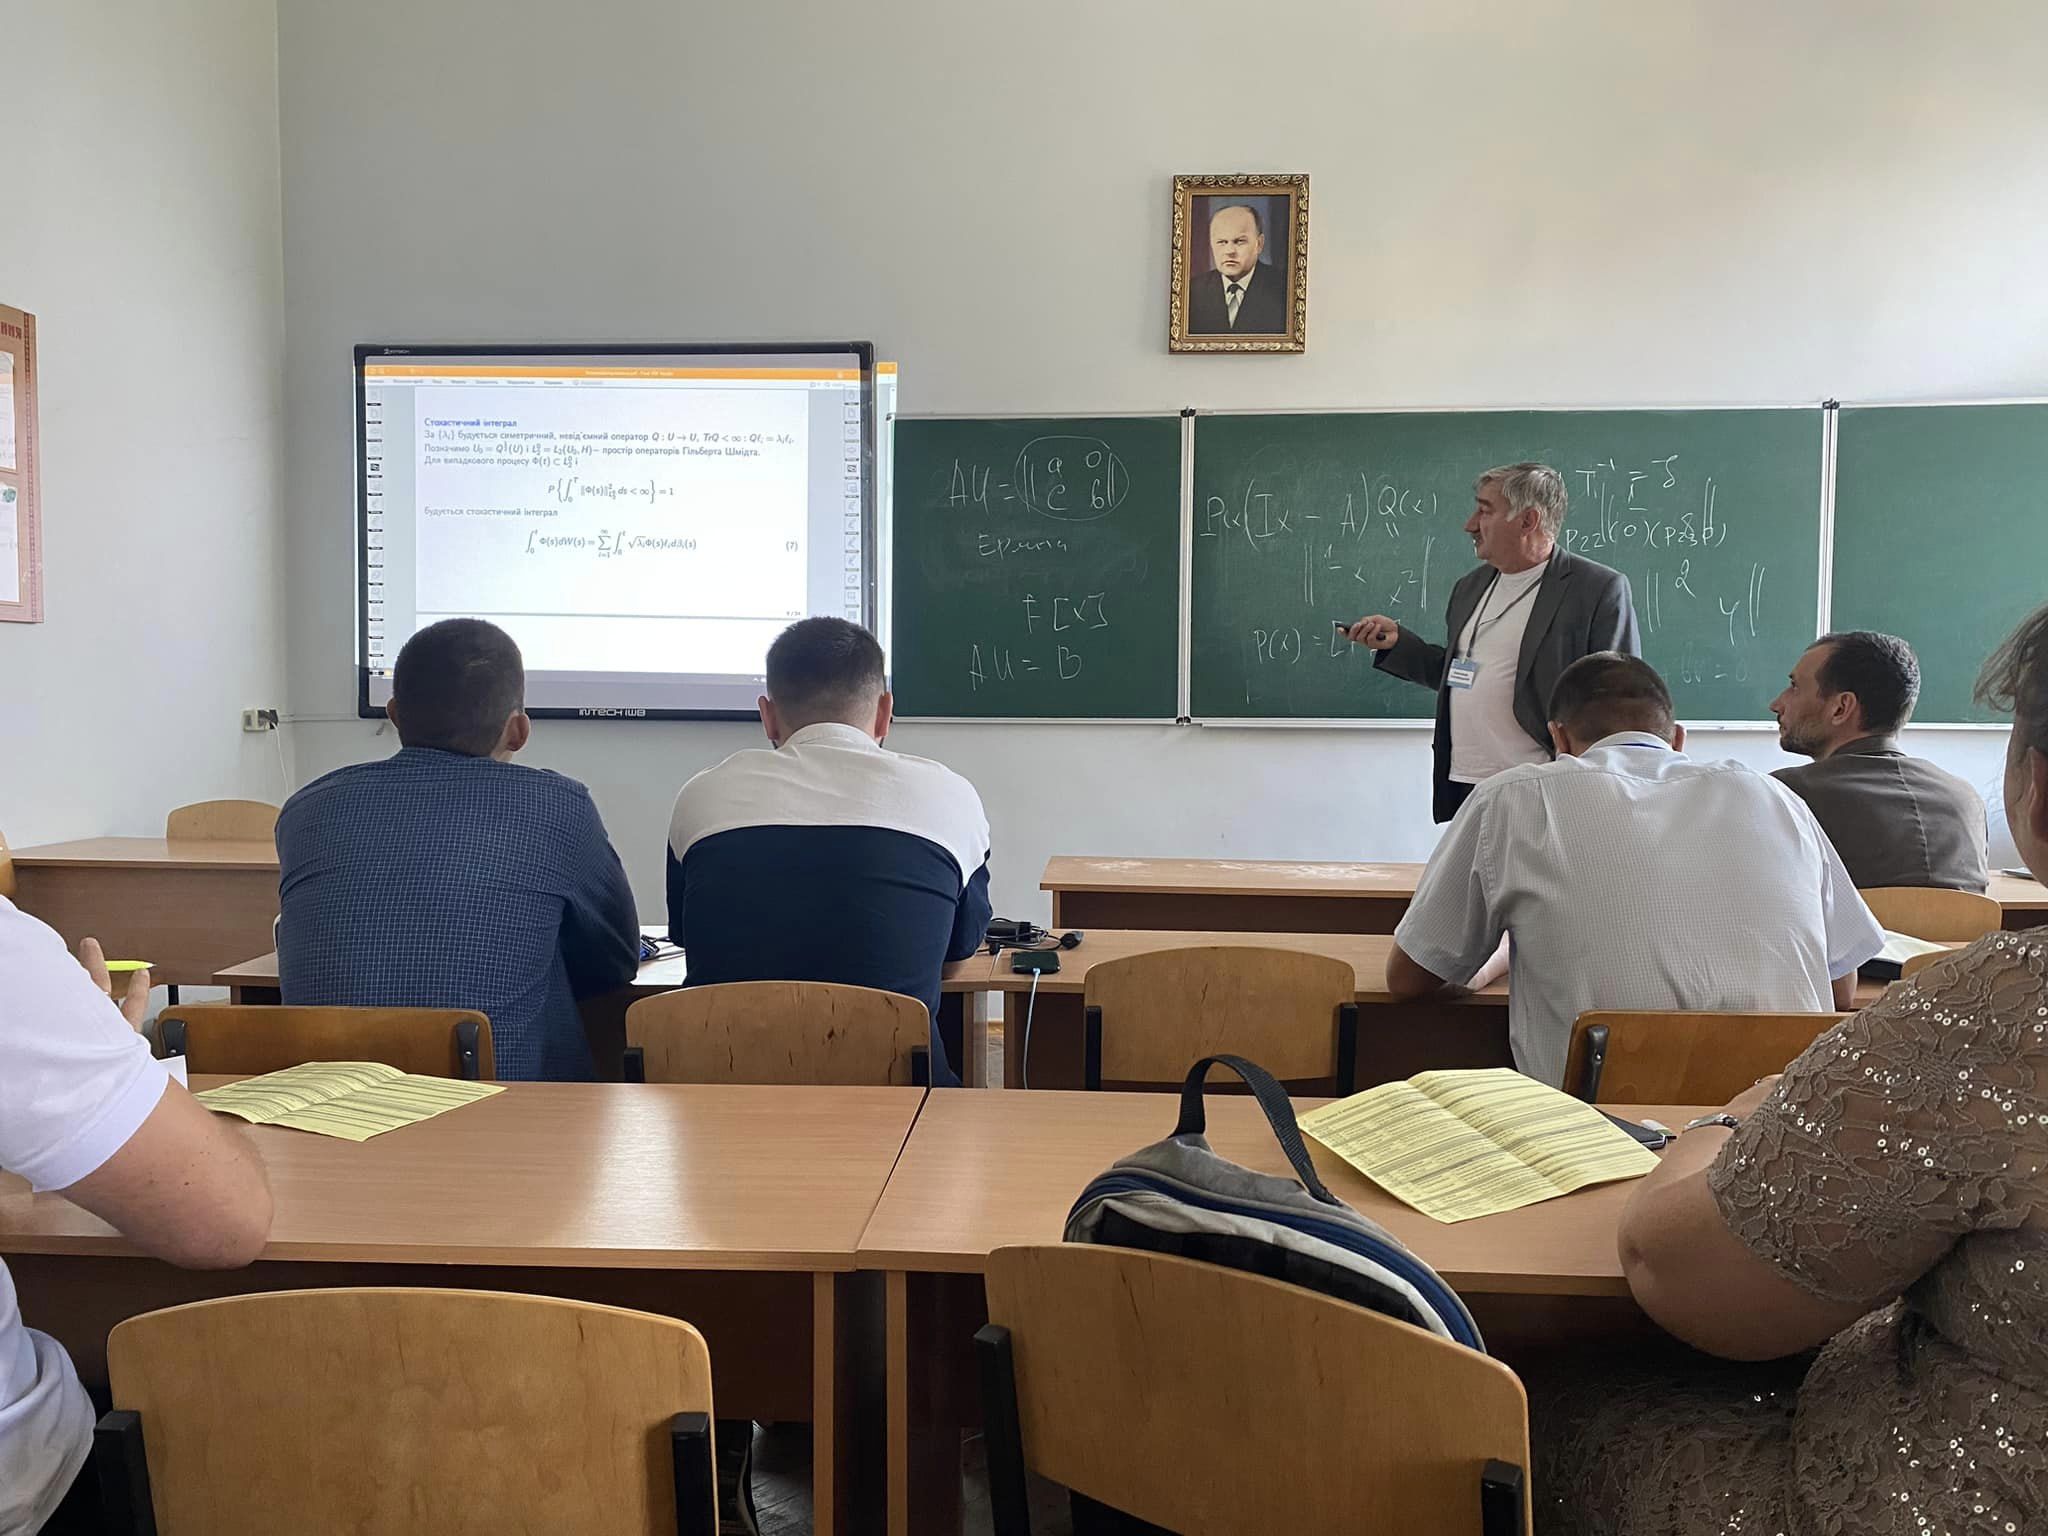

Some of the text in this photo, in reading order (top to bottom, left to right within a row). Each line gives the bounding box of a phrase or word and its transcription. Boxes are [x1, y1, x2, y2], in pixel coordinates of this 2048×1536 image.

[424, 418, 517, 428] Стохастичний інтеграл
[424, 431, 435, 439] За
[458, 431, 498, 441] будується
[610, 433, 648, 442] оператор
[703, 432, 719, 442] TrQ
[424, 443, 470, 453] Позначимо
[602, 447, 633, 456] простір
[635, 447, 680, 456] операторів
[682, 447, 722, 457] Гільберта
[725, 448, 760, 457] Шмідта.
[424, 456, 441, 465] Для
[444, 457, 495, 465] випадкового
[497, 458, 529, 467] процесу
[424, 506, 558, 518] будується стохастичний інтеграл
